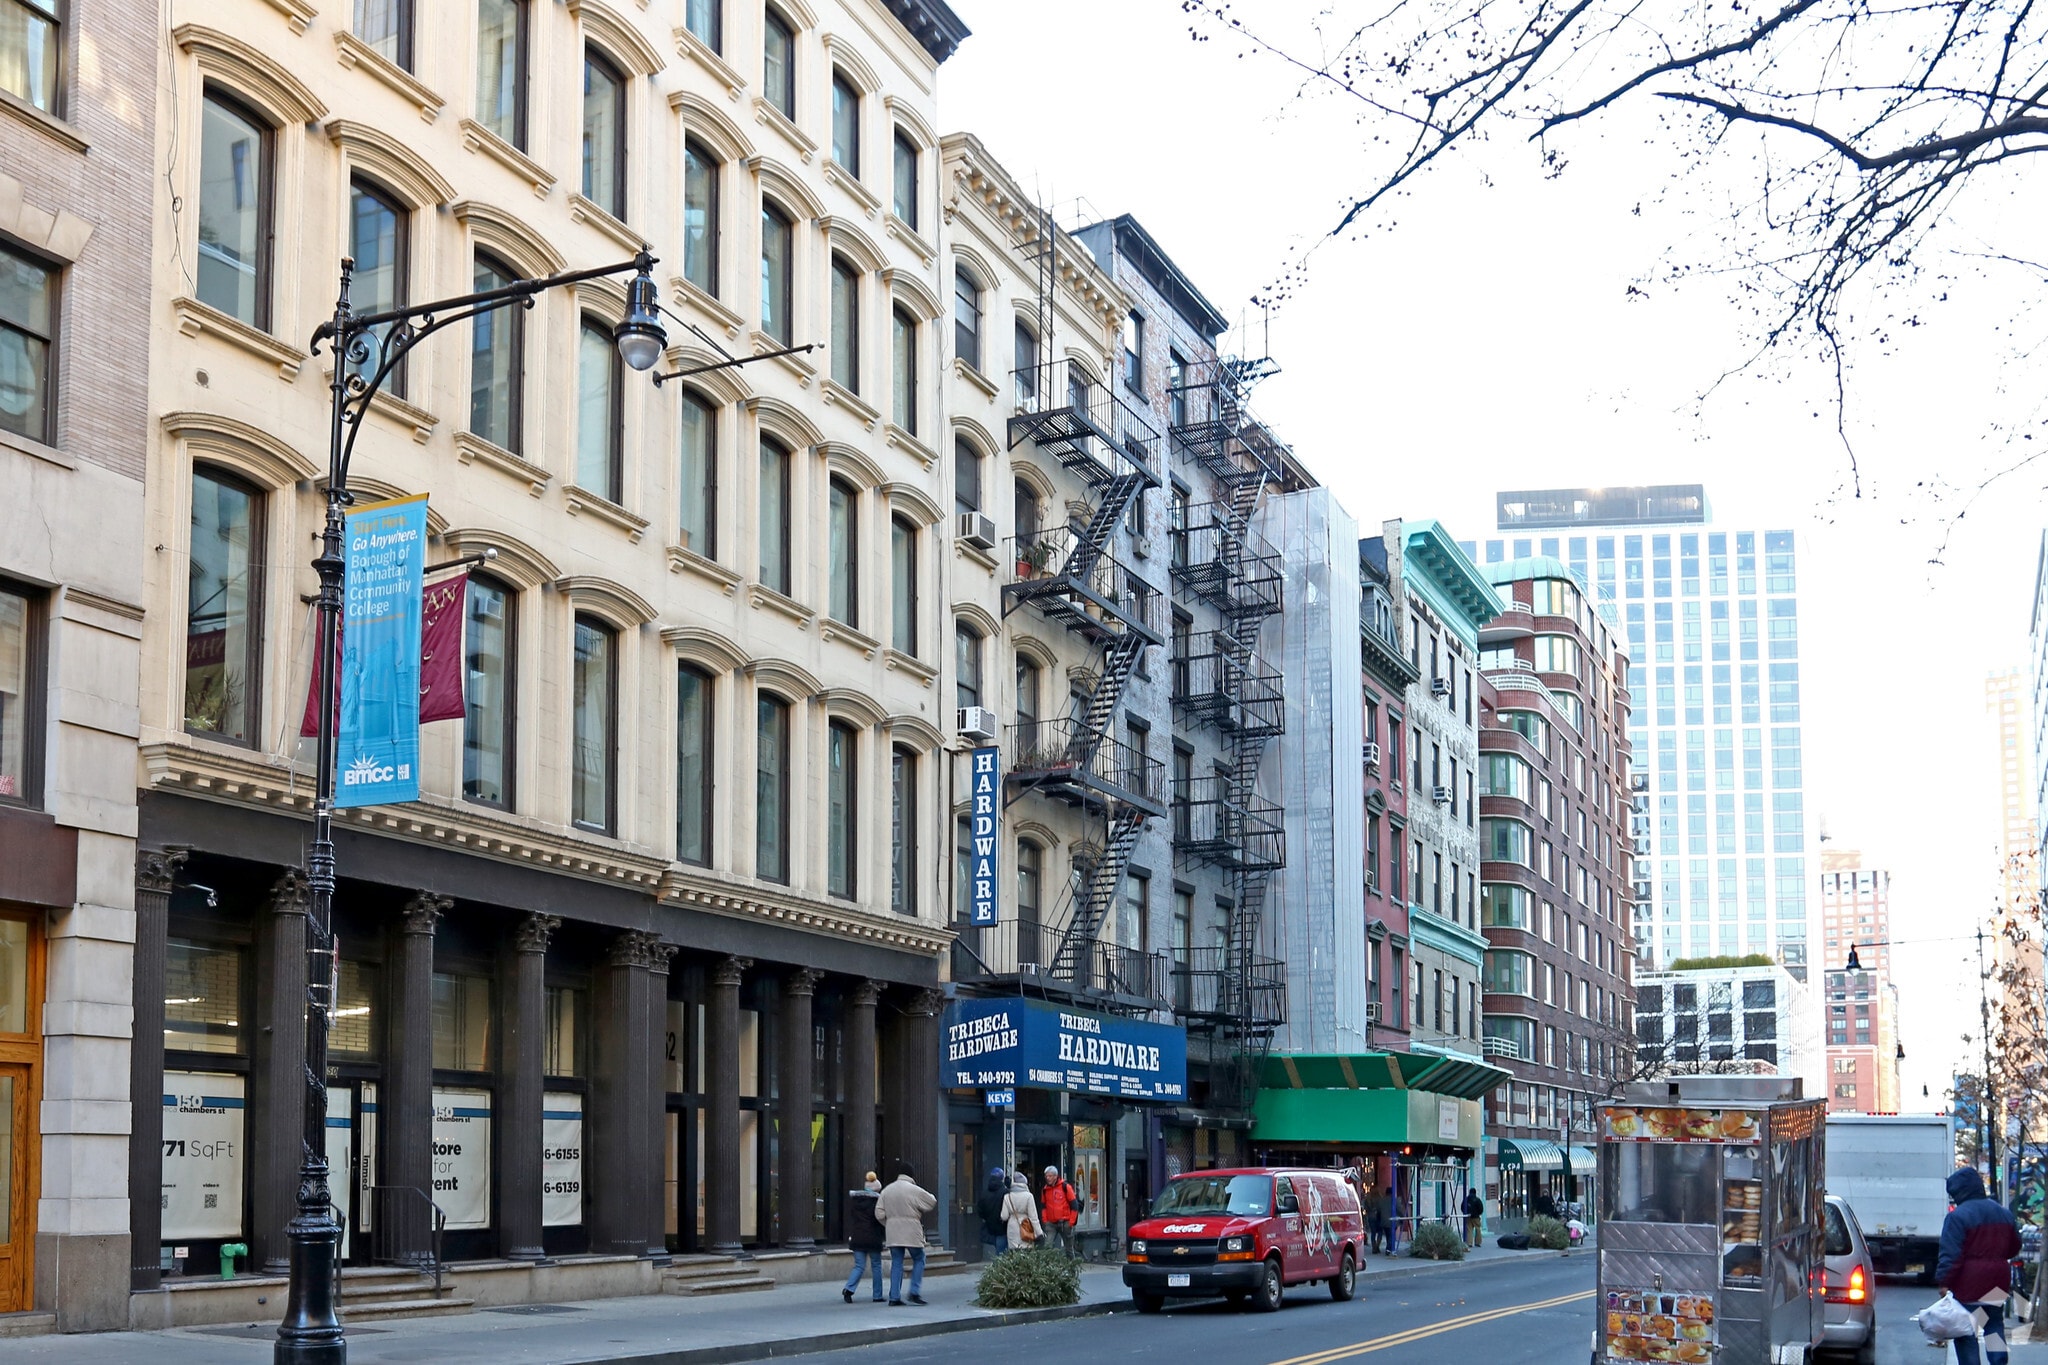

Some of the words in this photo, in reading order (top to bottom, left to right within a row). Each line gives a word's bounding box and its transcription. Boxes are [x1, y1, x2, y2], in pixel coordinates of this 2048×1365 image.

[354, 519, 379, 535] Start
[353, 538, 367, 551] Go
[370, 529, 418, 549] Anywhere.
[352, 549, 395, 568] Borough
[399, 545, 410, 560] of
[351, 564, 407, 585] Manhattan
[350, 579, 411, 600] Community
[349, 600, 389, 616] College
[975, 754, 994, 921] HARDWARE
[949, 1012, 1010, 1042] TRIBECA
[1060, 1013, 1101, 1034] TRIBECA
[949, 1029, 1018, 1061] HARDWARE
[1058, 1033, 1160, 1072] HARDWARE
[957, 1072, 974, 1084] TEL.
[978, 1071, 1015, 1084] 240-9792
[1037, 1069, 1058, 1084] CHAMBERS
[988, 1093, 1012, 1104] KEYS
[179, 1106, 217, 1114] chambers
[162, 1140, 185, 1157] 71
[191, 1140, 234, 1160] SqFt
[434, 1159, 453, 1173] for
[432, 1177, 459, 1191] ent
